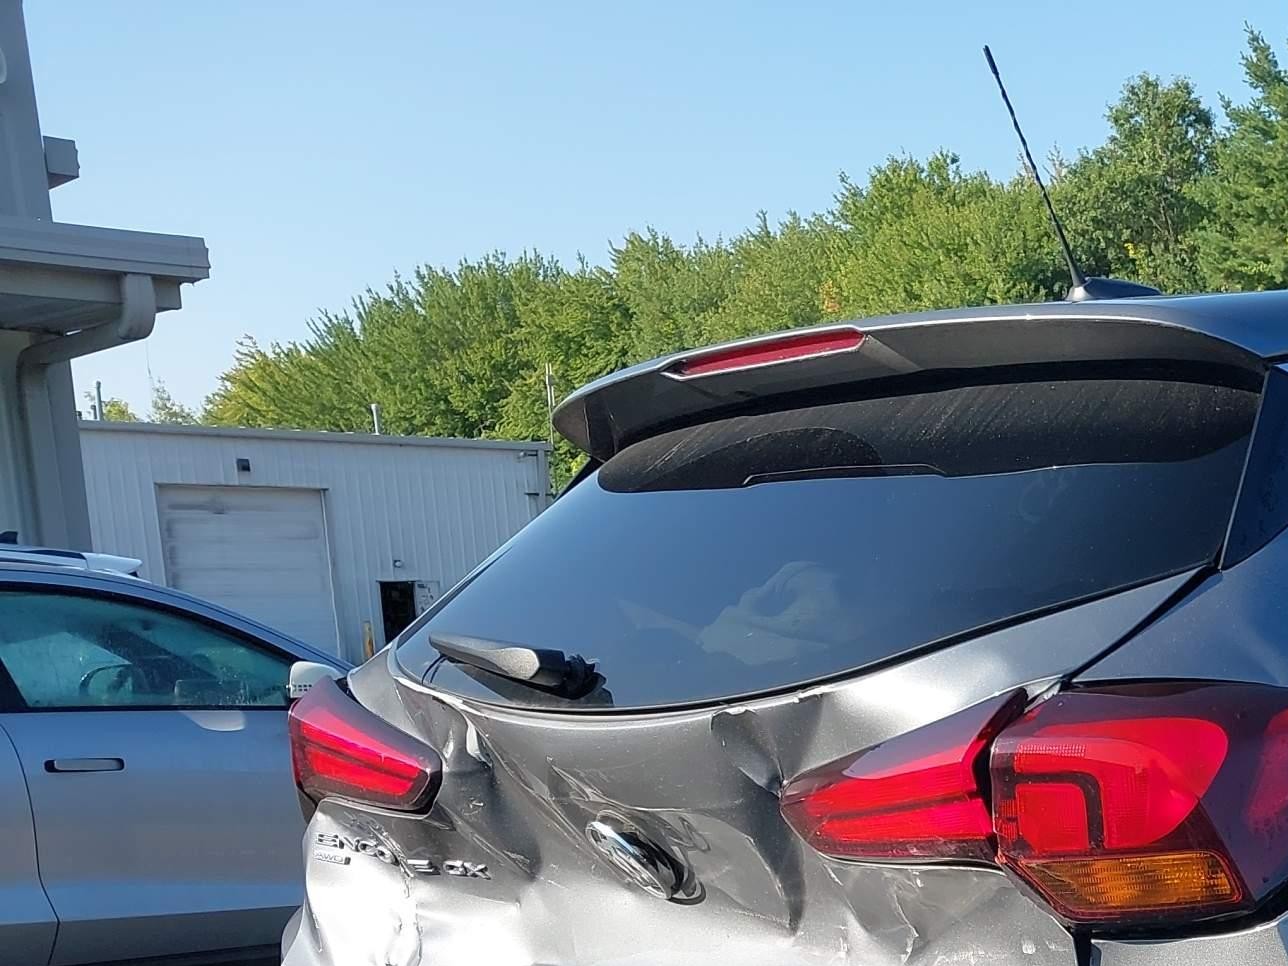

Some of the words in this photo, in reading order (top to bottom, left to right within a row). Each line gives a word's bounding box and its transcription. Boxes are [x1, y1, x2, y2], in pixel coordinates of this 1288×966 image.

[313, 852, 346, 865] AWD
[315, 833, 441, 875] ENCOE
[442, 859, 491, 880] GX
